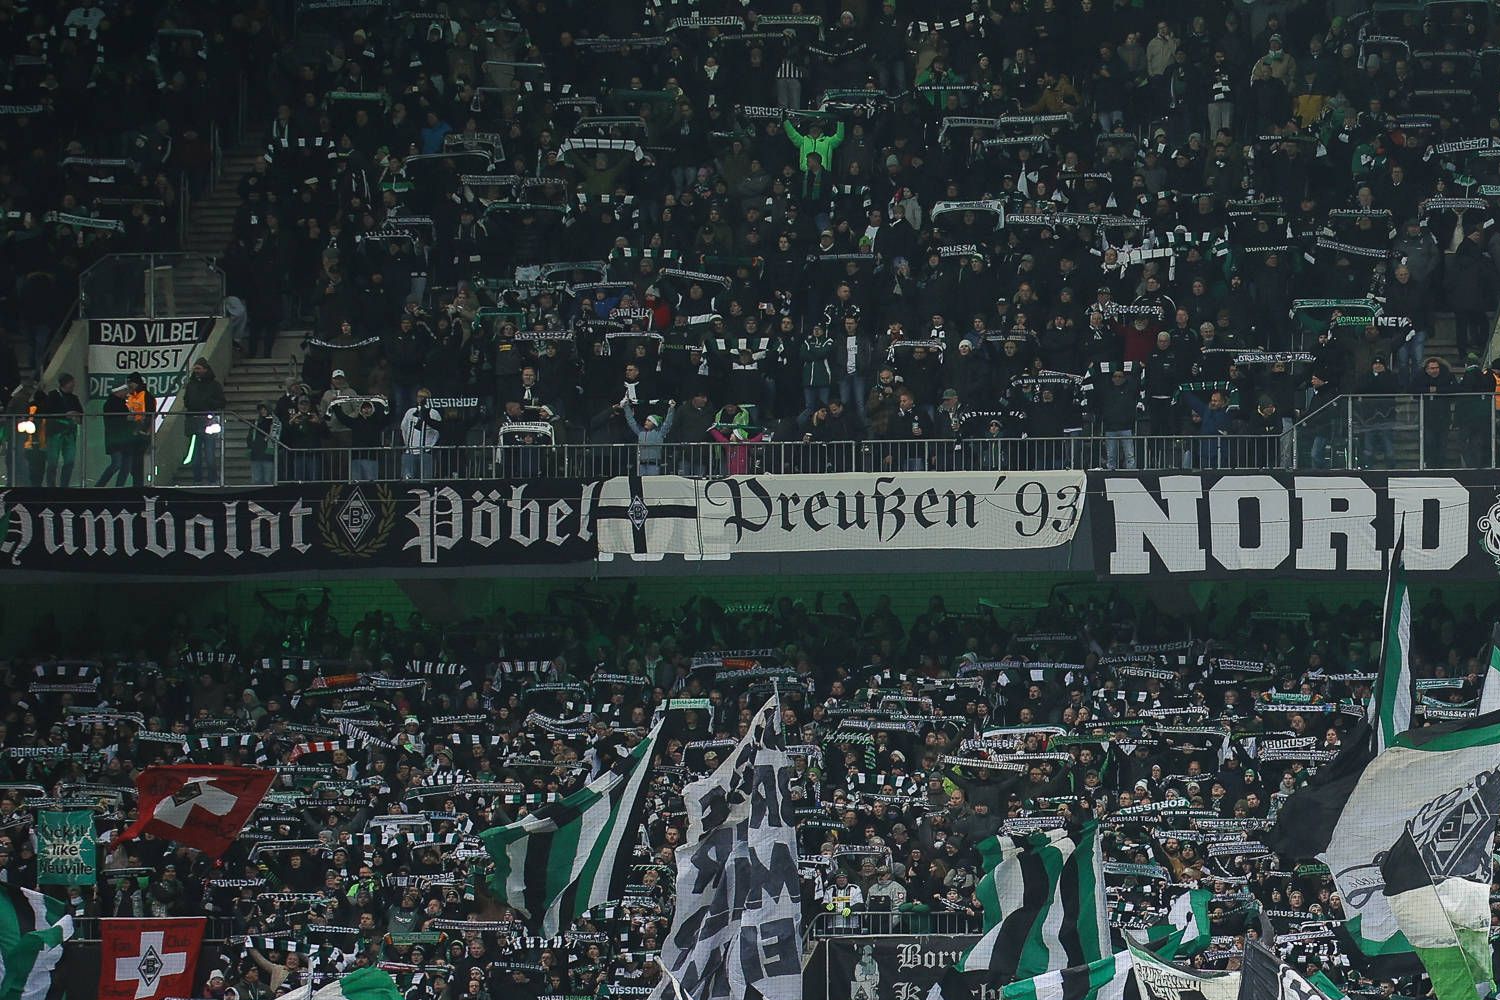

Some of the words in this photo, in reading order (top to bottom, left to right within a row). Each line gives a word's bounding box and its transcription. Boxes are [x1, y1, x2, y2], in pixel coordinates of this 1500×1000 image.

[100, 322, 136, 342] BAD
[144, 321, 199, 343] VILBEL
[116, 350, 182, 370] GRÜSST
[403, 482, 600, 562] Pöbel
[704, 475, 980, 543] Preußen
[1105, 474, 1470, 575] NORD
[52, 843, 78, 857] like
